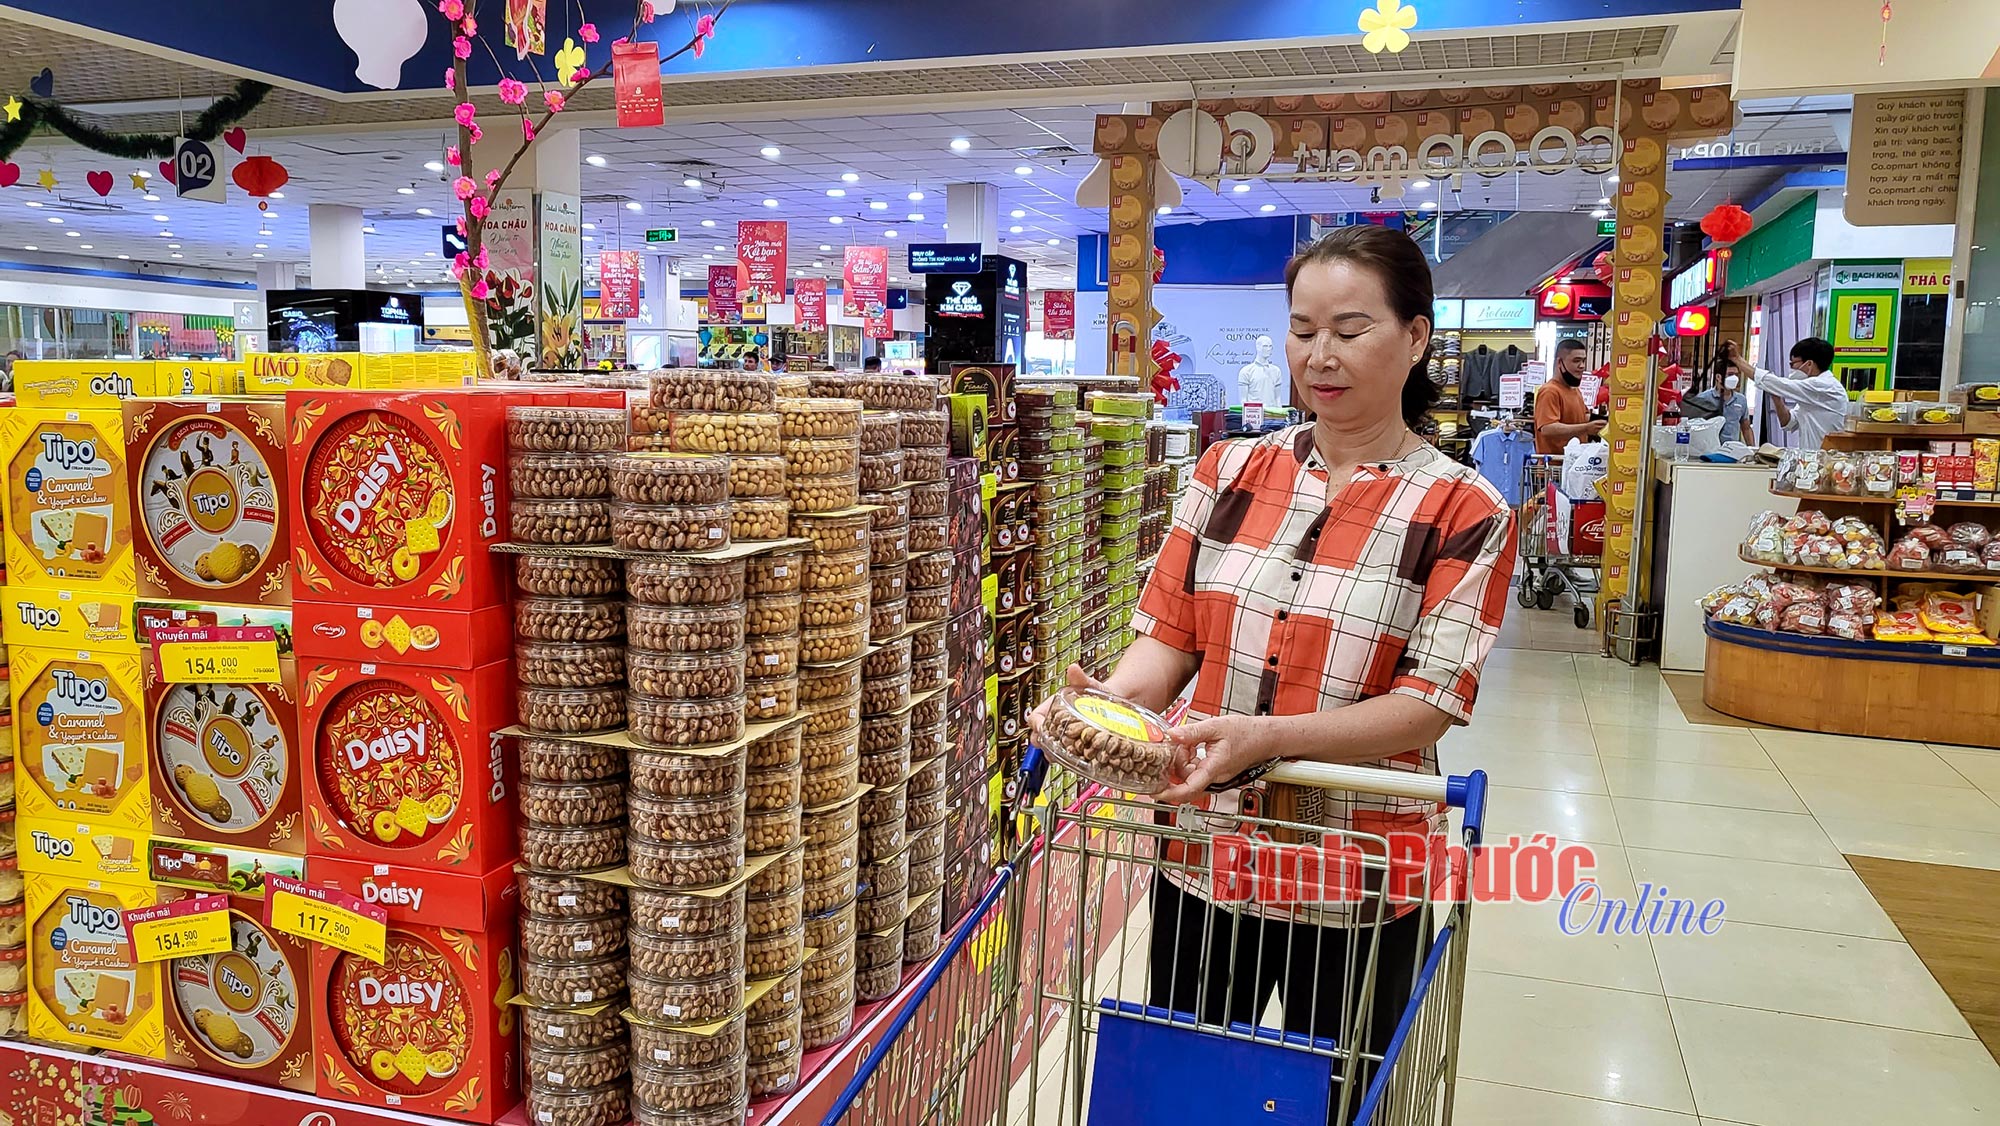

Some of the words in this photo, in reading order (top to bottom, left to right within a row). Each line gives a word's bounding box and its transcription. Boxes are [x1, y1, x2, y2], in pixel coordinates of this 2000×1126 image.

[1645, 95, 1653, 103] LU
[1692, 91, 1701, 100] LU
[1597, 99, 1606, 107] LU
[1899, 101, 1925, 109] khách
[1930, 100, 1942, 108] vui
[1506, 107, 1514, 115] LU
[1100, 117, 1108, 126] LU
[1336, 120, 1343, 128] LU
[1419, 115, 1427, 123] LU
[1875, 126, 1888, 134] Xin
[1912, 125, 1938, 133] khách
[1626, 140, 1635, 149] LU
[180, 151, 212, 180] 02
[1871, 162, 1918, 171] Co.opmart
[1922, 161, 1950, 170] không
[1624, 184, 1633, 193] LU
[1868, 186, 1915, 195] Co.opmart
[1114, 197, 1121, 205] LU
[1867, 198, 1894, 206] khách
[1897, 198, 1920, 207] trong
[502, 218, 527, 232] CHẬU
[545, 222, 558, 232] HOA
[560, 222, 577, 235] CẢNH
[1623, 227, 1631, 236] LU
[761, 247, 777, 257] bạn
[1113, 276, 1119, 284] LU
[1621, 270, 1630, 279] LU
[1876, 271, 1899, 279] KHOA
[1909, 272, 1937, 286] THẢ
[1477, 305, 1524, 319] Roland
[1620, 313, 1629, 321] LU
[1226, 332, 1243, 342] QUÝ
[253, 356, 299, 377] LIMO
[1619, 356, 1627, 365] LU
[90, 372, 138, 400] Tipo
[1617, 399, 1625, 408] LU
[190, 422, 213, 430] QUALITY
[40, 433, 96, 470] Tipo
[46, 473, 94, 493] Caramel
[335, 441, 403, 533] Daisy
[1614, 483, 1623, 492] LU
[37, 490, 47, 504] &
[48, 495, 75, 510] Yogurt
[81, 493, 107, 504] Cashew
[193, 492, 230, 515] Tipo
[481, 463, 496, 537] Daisy
[1611, 566, 1619, 575] LU
[18, 602, 60, 628] Tipo
[143, 616, 169, 629] Tipo
[156, 630, 190, 642] Khuyến
[191, 630, 208, 640] mãi
[185, 657, 221, 674] 154.
[221, 657, 238, 667] 000
[52, 669, 107, 706] Tipo
[58, 711, 105, 728] Caramel
[49, 725, 59, 739] &
[60, 731, 86, 744] Yogurt
[92, 730, 118, 740] Cashew
[209, 727, 242, 766] Tipo
[345, 722, 426, 770] Daisy
[488, 732, 505, 802] Daisy
[31, 830, 74, 857] Tipo
[158, 855, 181, 871] Tipo
[272, 877, 306, 895] Khuyến
[309, 889, 326, 900] mãi
[362, 881, 423, 911] Daisy
[66, 896, 120, 933] Tipo
[128, 910, 155, 922] Khuyến
[157, 908, 171, 917] mãi
[298, 912, 332, 936] 117.
[334, 922, 350, 936] 500
[71, 938, 118, 956] Caramel
[155, 932, 185, 951] 154.
[184, 930, 198, 940] 500
[62, 949, 71, 964] &
[73, 956, 99, 970] Yogurt
[104, 958, 130, 968] Cashew
[221, 966, 252, 998] Tipo
[359, 974, 443, 1012] Daisy
